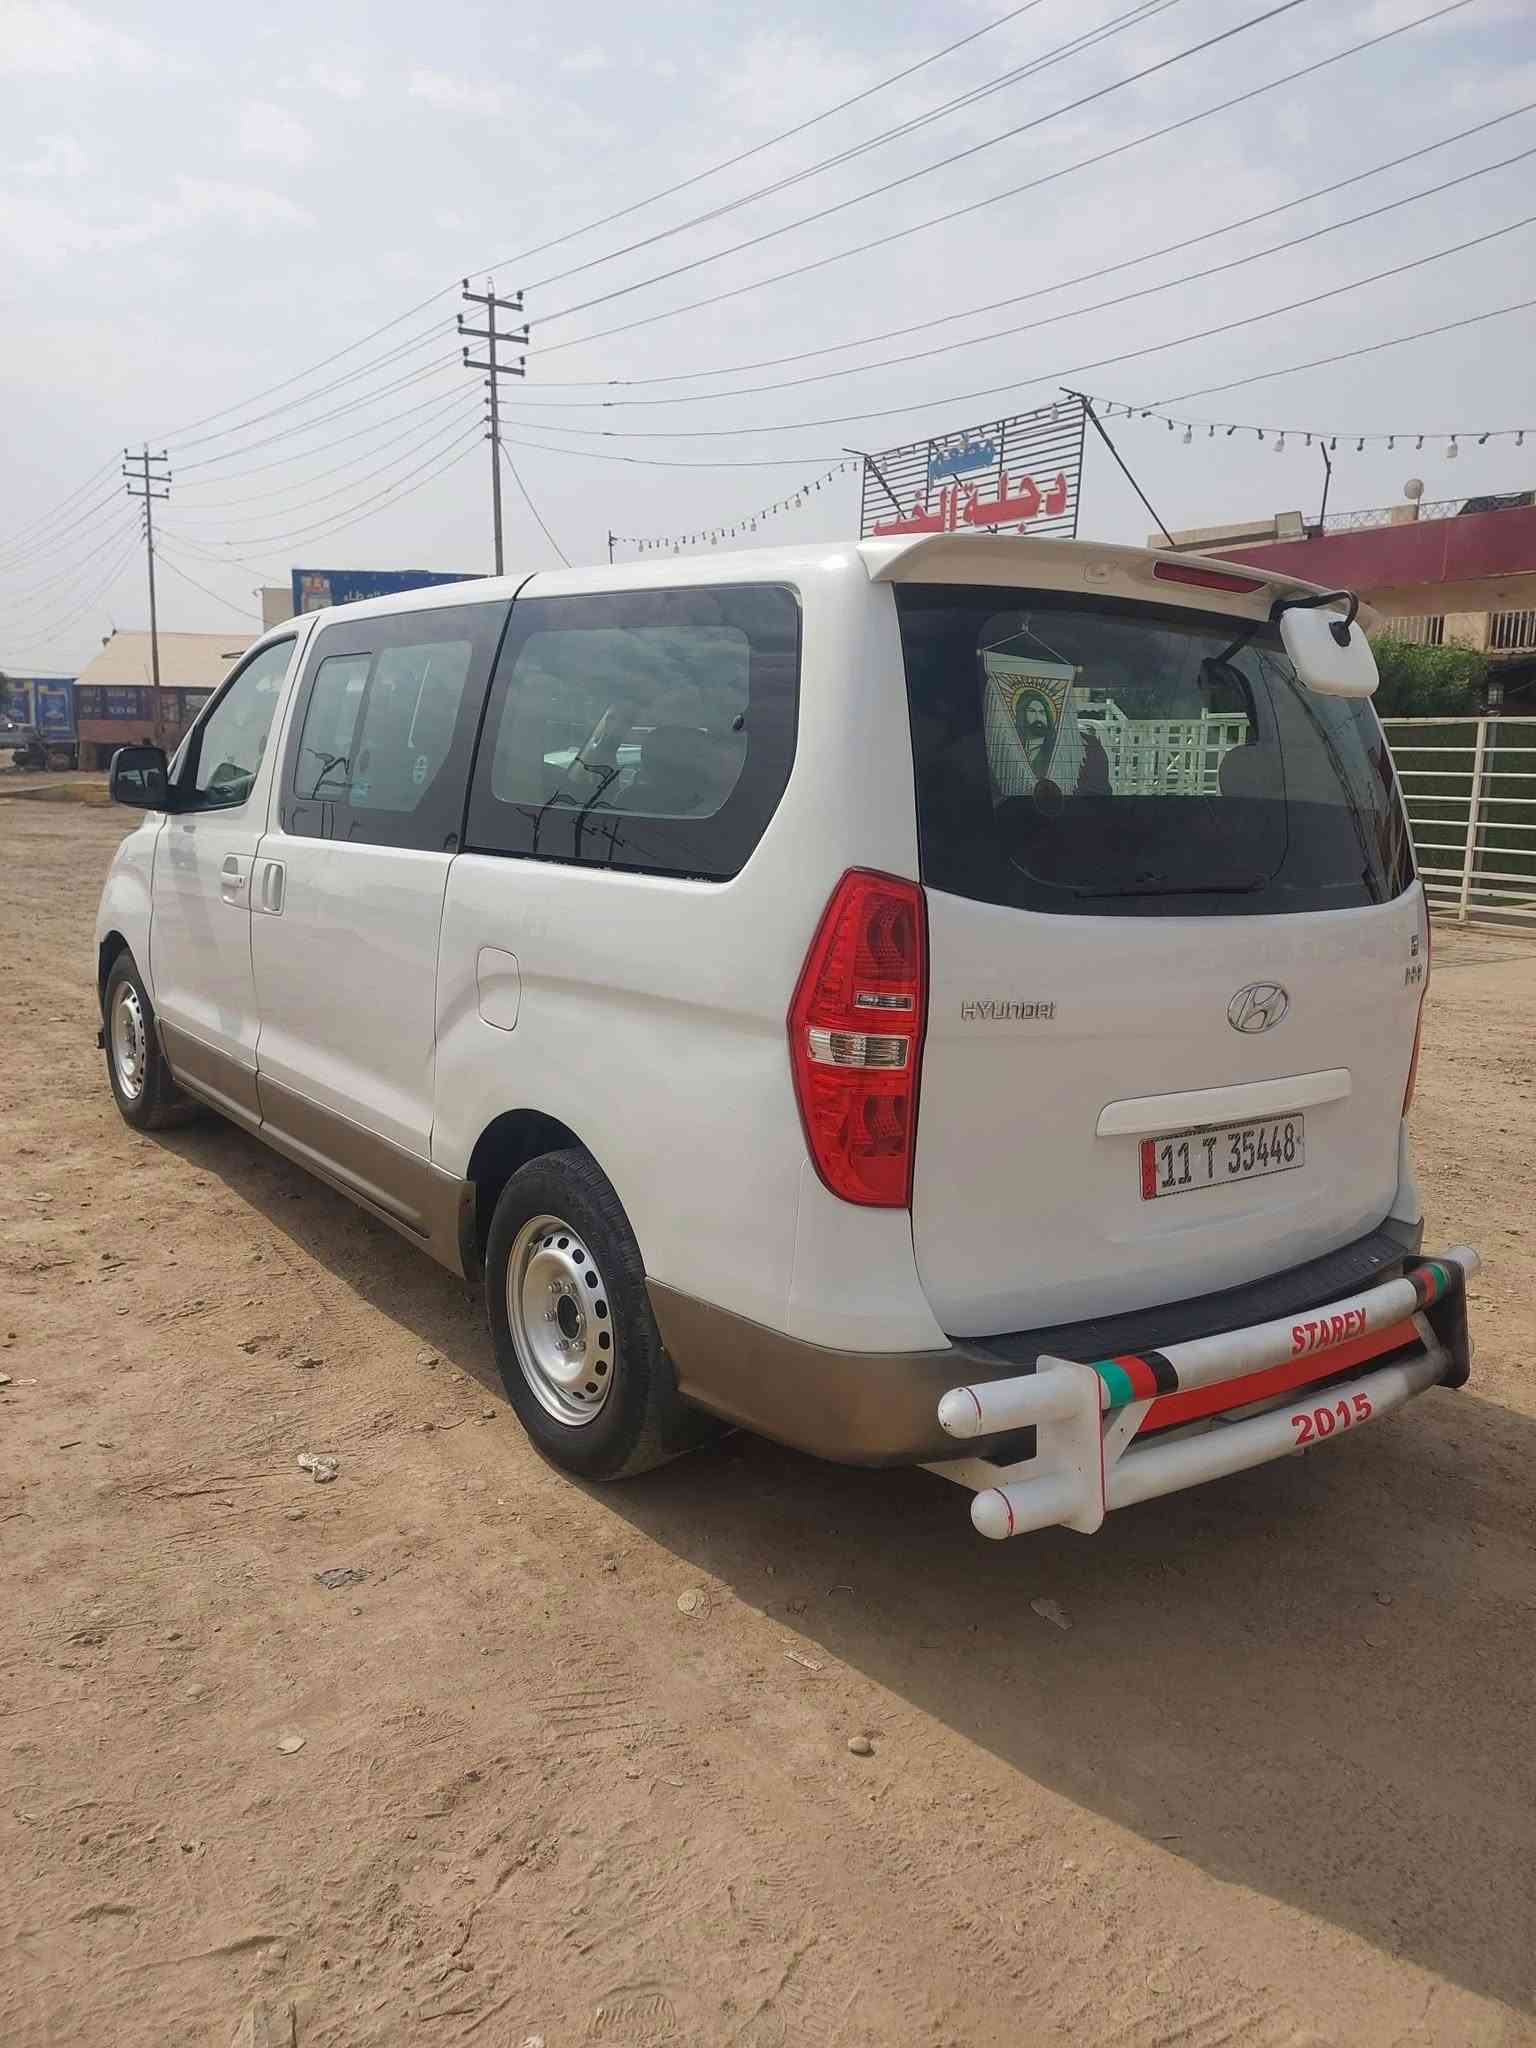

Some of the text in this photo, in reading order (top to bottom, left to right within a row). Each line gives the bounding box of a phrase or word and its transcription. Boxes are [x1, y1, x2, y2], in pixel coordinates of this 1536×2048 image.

[961, 1000, 1056, 1020] HYUNDAI
[1160, 1142, 1192, 1187] 11
[1228, 1121, 1296, 1174] 35448
[1291, 1392, 1373, 1446] 2015
